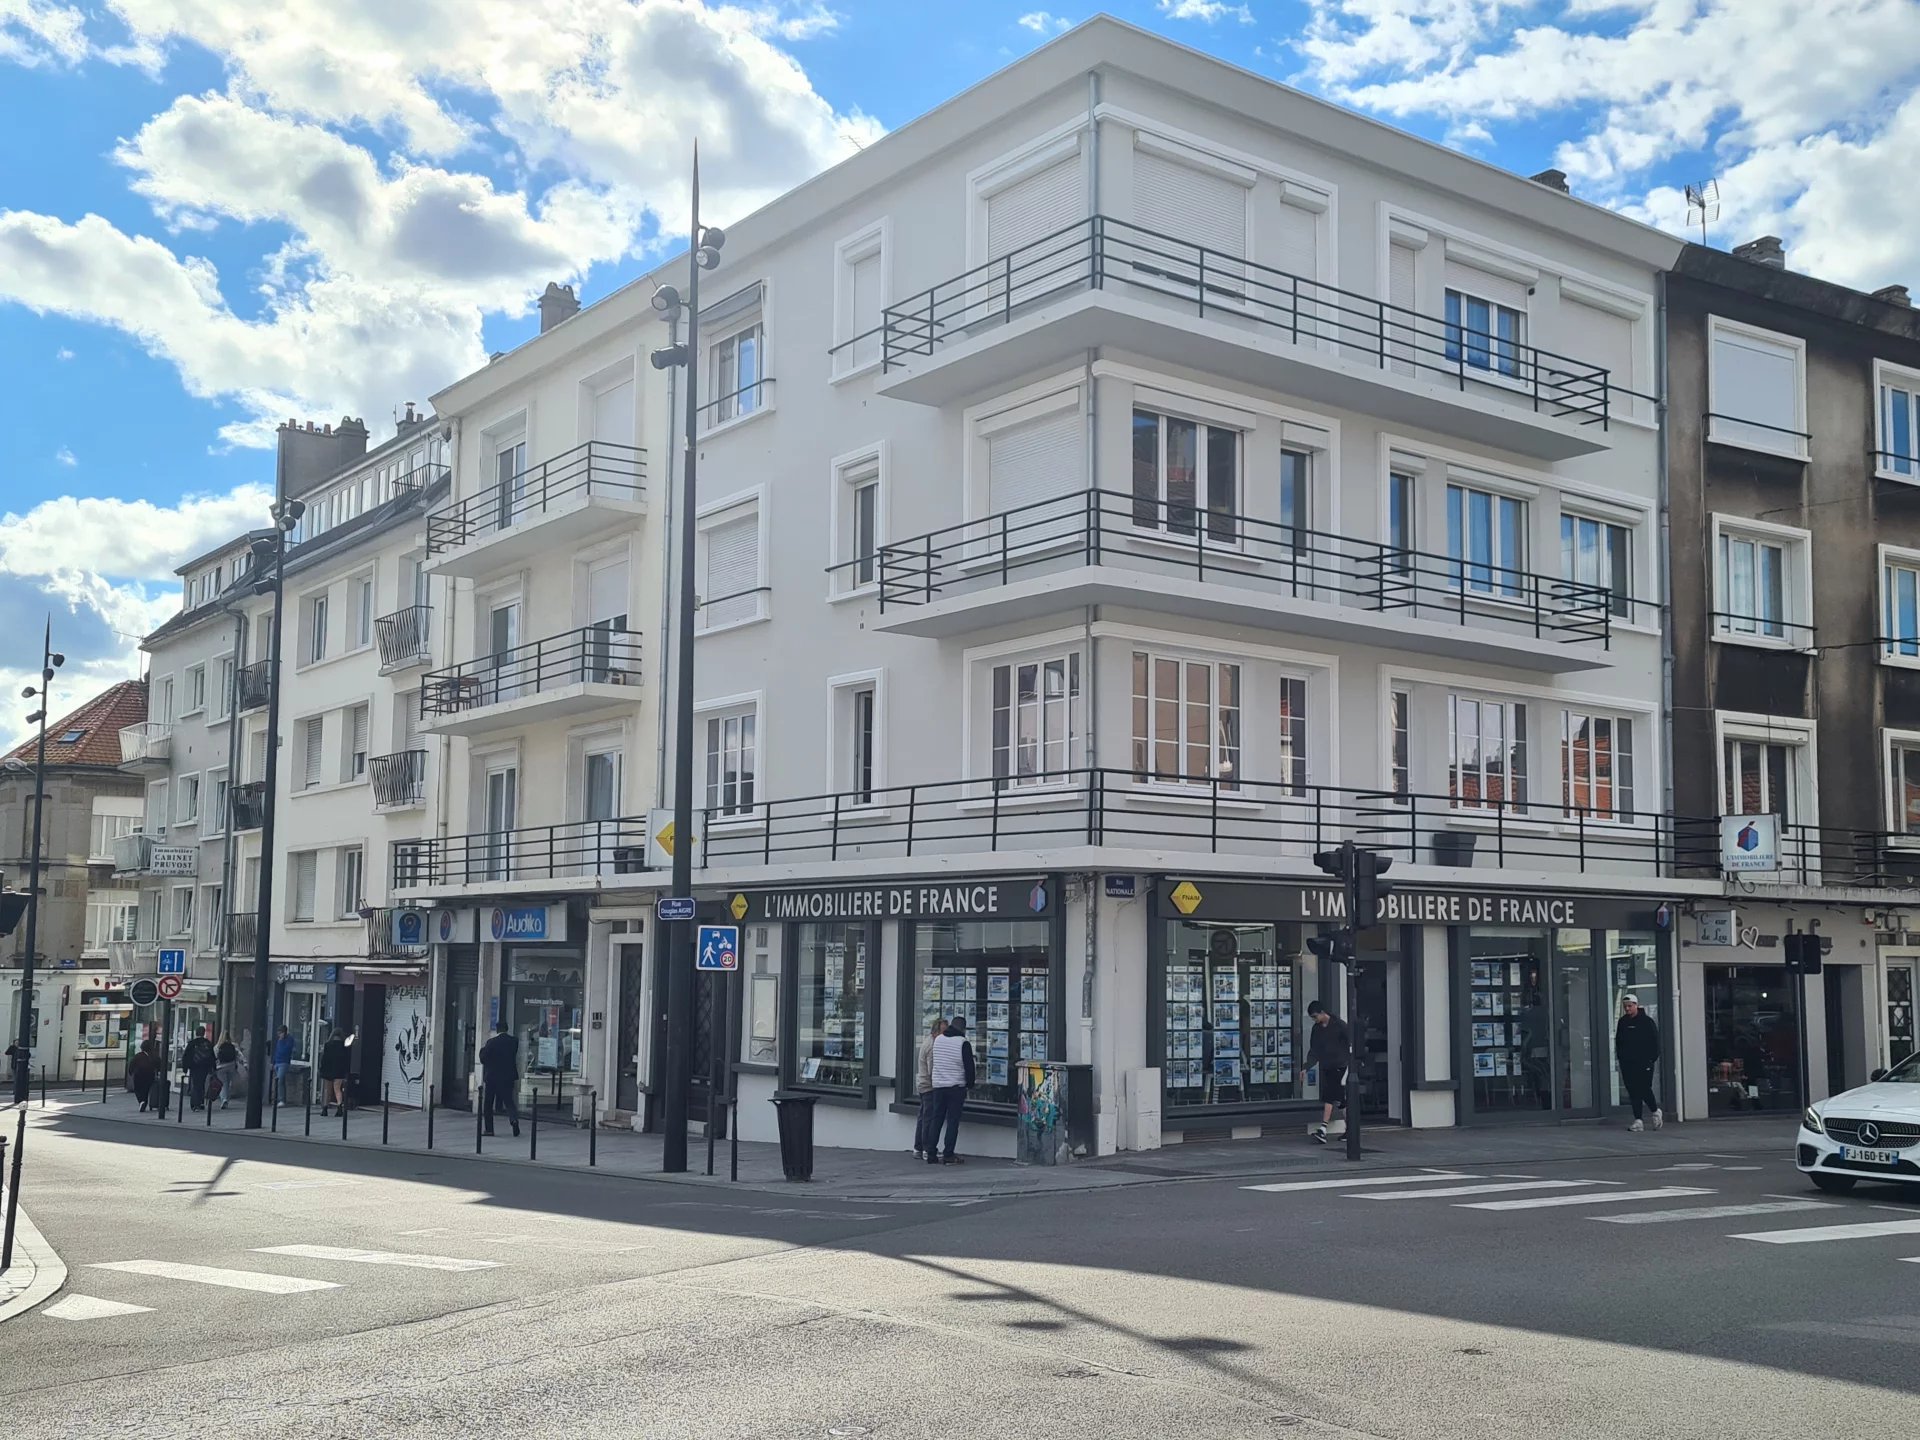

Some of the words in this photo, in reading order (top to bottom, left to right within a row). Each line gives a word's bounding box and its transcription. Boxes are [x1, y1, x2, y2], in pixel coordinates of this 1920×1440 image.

[764, 890, 882, 917] L'IMMOBILIERE
[889, 889, 912, 915] DE
[919, 886, 998, 914] FRANCE
[1468, 898, 1492, 921] DE
[1500, 898, 1574, 924] FRANCE
[507, 913, 542, 933] Audika
[1846, 1149, 1890, 1162] FJ-160-EW
